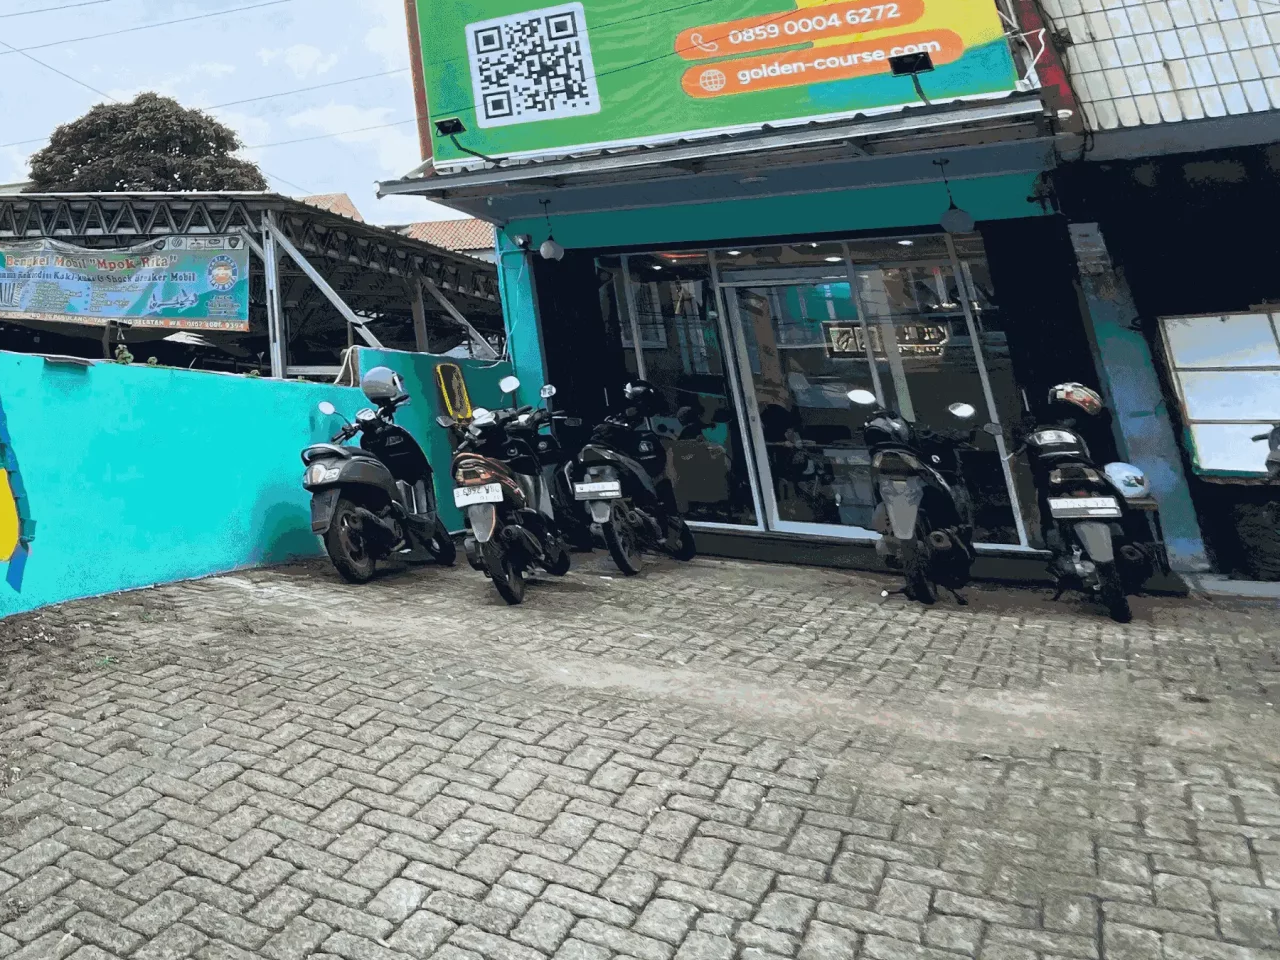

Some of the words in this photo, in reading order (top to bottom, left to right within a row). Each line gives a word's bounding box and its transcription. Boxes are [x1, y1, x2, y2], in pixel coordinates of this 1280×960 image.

[729, 23, 779, 45] 0859
[784, 13, 842, 36] 0004
[846, 2, 900, 26] 6272
[54, 255, 87, 269] Mobil
[170, 272, 196, 282] Mobil
